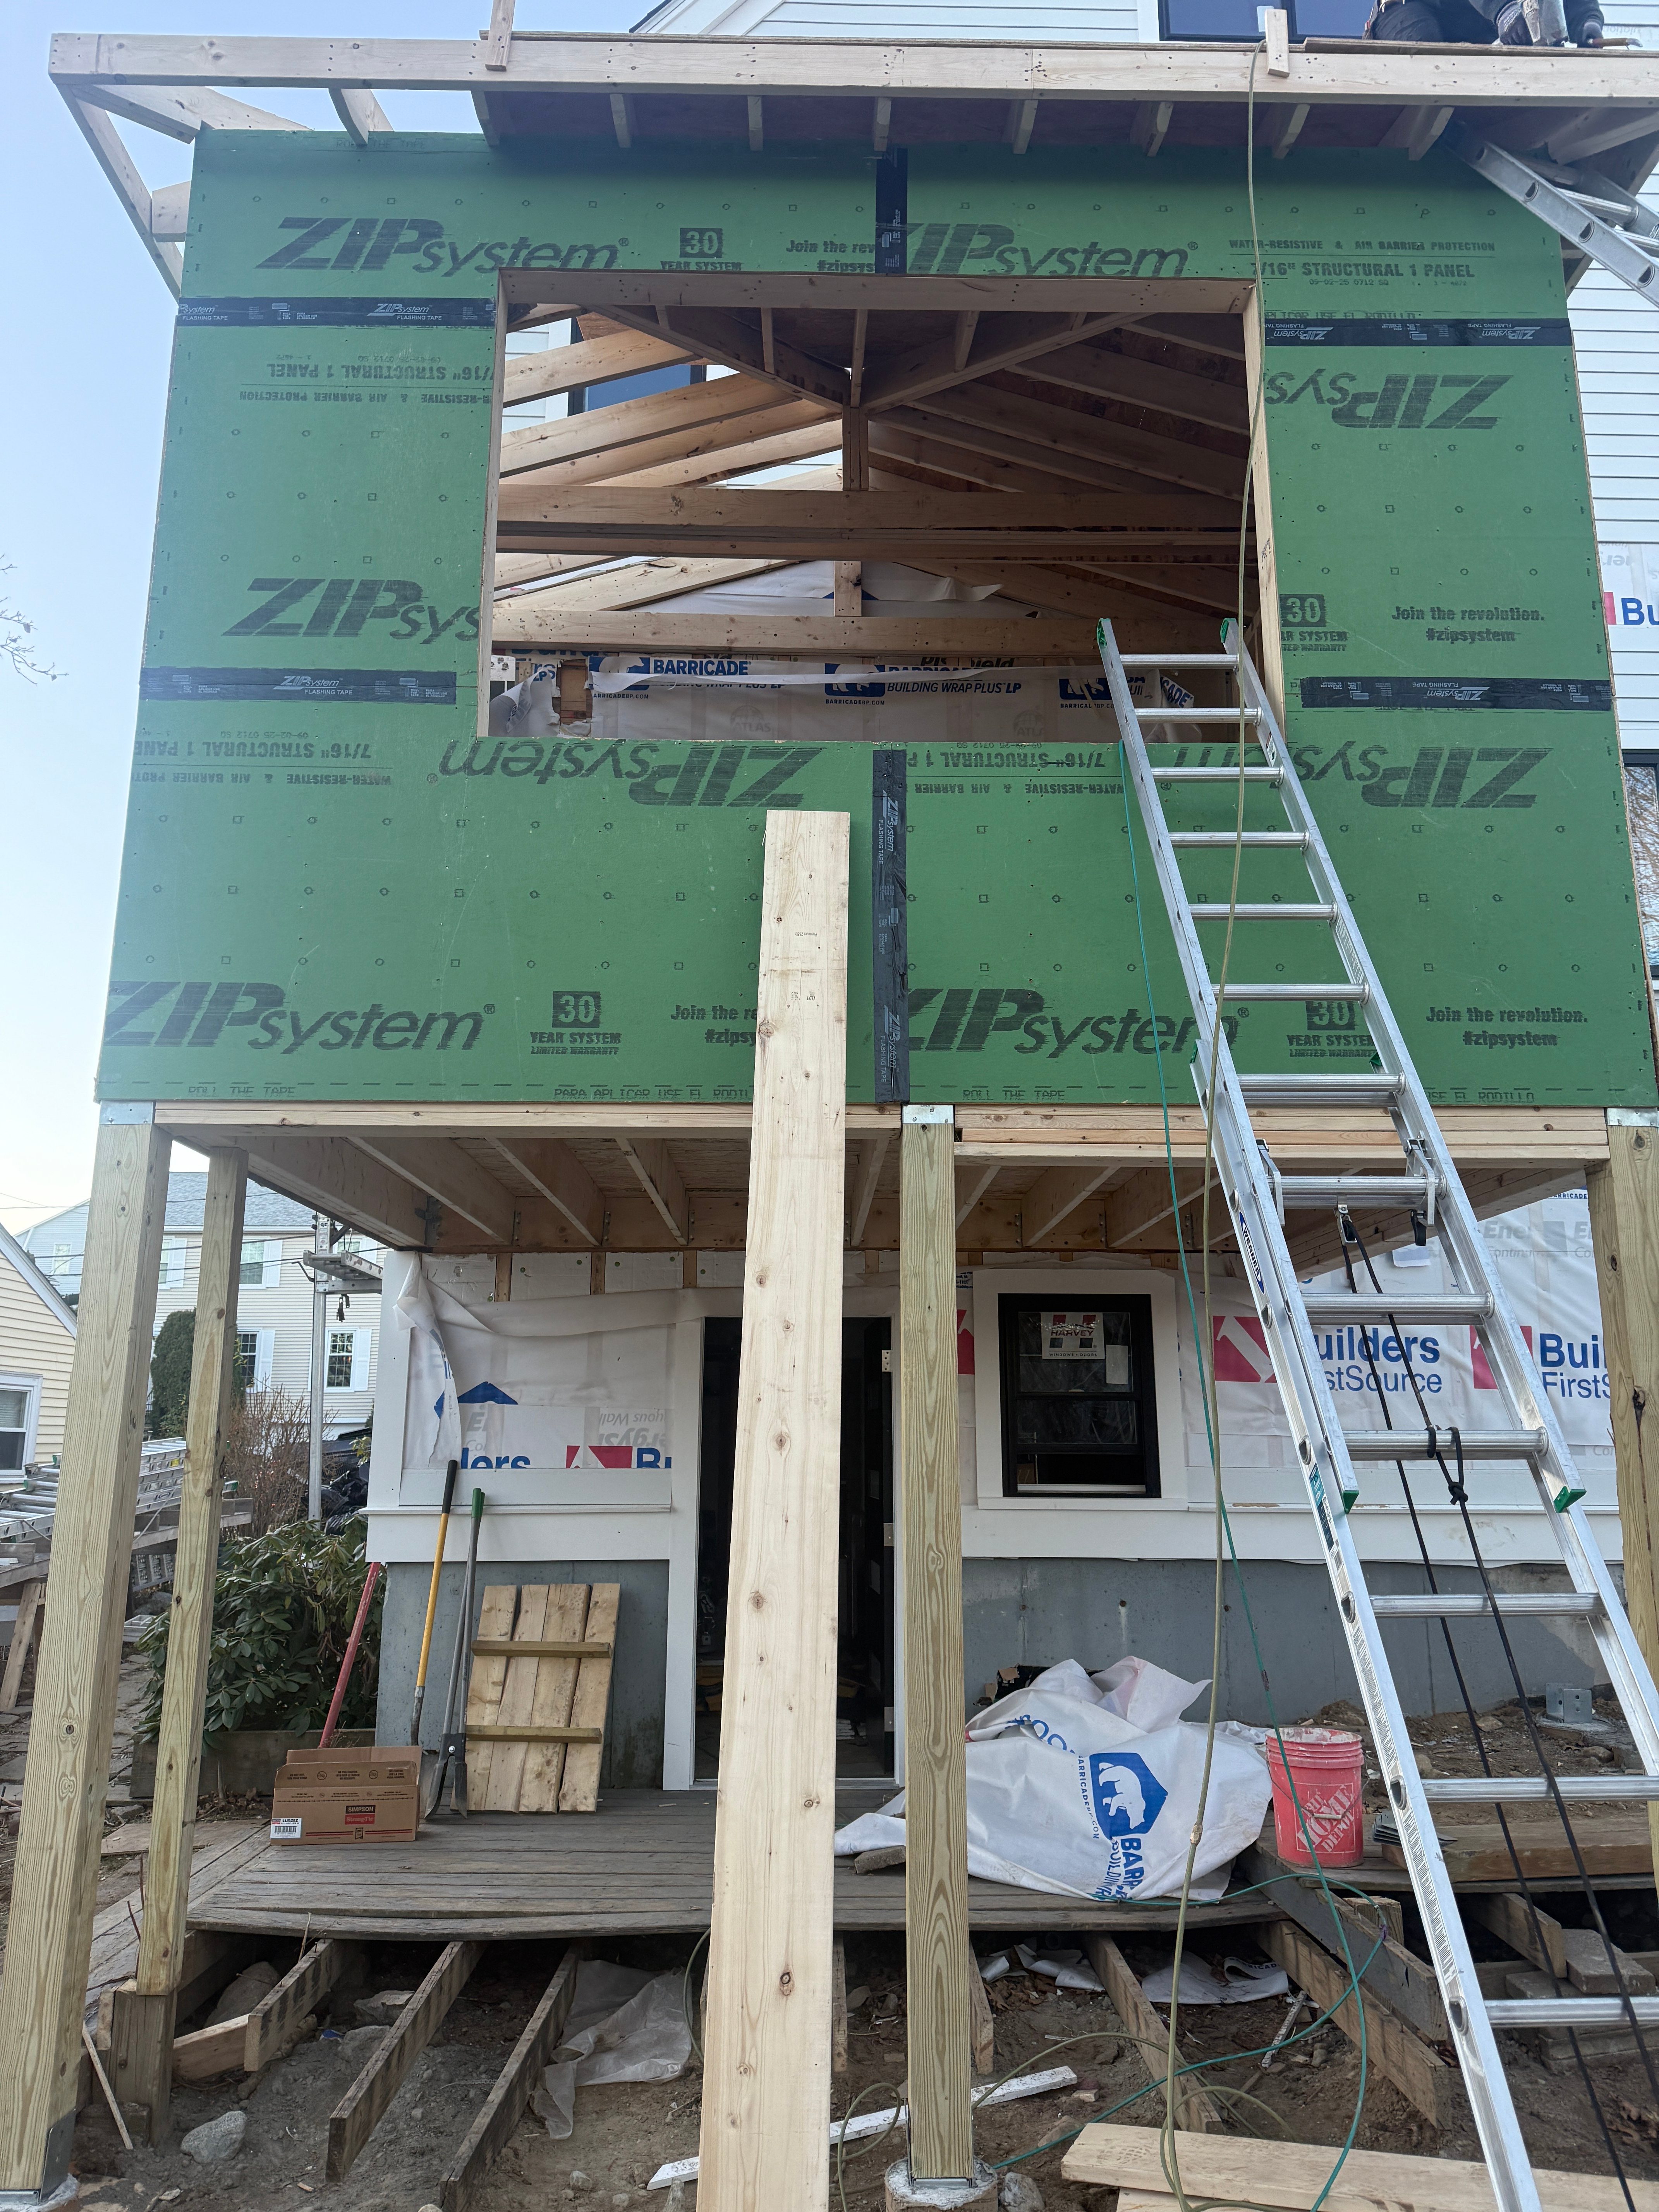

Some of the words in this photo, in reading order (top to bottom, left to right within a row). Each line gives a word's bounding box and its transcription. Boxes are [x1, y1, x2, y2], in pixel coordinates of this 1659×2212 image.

[686, 231, 718, 254] 30
[786, 240, 818, 252] Join
[823, 240, 847, 253] the
[1335, 240, 1343, 249] &
[1356, 241, 1373, 250] AIR
[1379, 241, 1425, 251] BARRIER
[1432, 242, 1495, 251] PROTECTION
[661, 261, 692, 271] YEAR
[696, 261, 743, 271] SYSTEM
[1302, 262, 1403, 277] STRUCTURAL
[1410, 264, 1417, 277] 1
[1424, 264, 1475, 278] PANEL
[267, 364, 319, 378] PANEL
[327, 365, 334, 378] 1
[342, 365, 446, 380] STRUCTURAL
[240, 390, 307, 401] PROTECTION
[314, 391, 362, 402] BARRIER
[369, 393, 387, 402] AIR
[401, 393, 408, 403] &
[1288, 598, 1320, 623] 30
[1392, 606, 1425, 620] Join
[1430, 606, 1455, 620] the
[1461, 607, 1545, 621] revolution.
[1299, 631, 1349, 642] SYSTEM
[1427, 628, 1516, 644] #zipsystem
[653, 659, 748, 676] BARRICADE
[887, 682, 938, 692] BUILDING
[941, 683, 972, 693] WRAP
[1005, 683, 1022, 694] LP
[187, 742, 193, 756] 1
[202, 741, 315, 758] STRUCTURAL
[926, 751, 934, 767] 1
[940, 752, 1049, 768] STRUCTURAL
[173, 773, 223, 783] BARRIER
[231, 774, 251, 784] AIR
[264, 774, 273, 783] &
[287, 774, 391, 786] WATER-RESISTIVE
[915, 783, 964, 793] BARRIER
[972, 783, 990, 793] AIR
[560, 995, 594, 1023] 30
[671, 1004, 706, 1020] Join
[711, 1005, 739, 1020] the
[1425, 1006, 1461, 1023] Join
[1467, 1007, 1494, 1022] the
[1500, 1008, 1588, 1024] revolution.
[530, 1030, 565, 1044] YEAR
[569, 1031, 622, 1044] SYSTEM
[1286, 1034, 1322, 1046] YEAR
[1462, 1031, 1558, 1049] #zipsystem
[230, 1086, 254, 1097] THE
[262, 1086, 296, 1097] TAPE
[553, 1089, 588, 1099] PARA
[593, 1089, 650, 1100] APLICAR
[658, 1089, 683, 1100] USE
[690, 1089, 701, 1100] EL
[962, 1090, 994, 1101] ROLL
[1002, 1090, 1025, 1101] THE
[1034, 1090, 1065, 1101] TAPE
[1455, 1091, 1470, 1103] EL
[1478, 1091, 1535, 1103] RODILLO
[1243, 1225, 1261, 1278] WERNER
[1298, 1785, 1354, 1849] HOME
[1321, 1811, 1354, 1852] DEPOT
